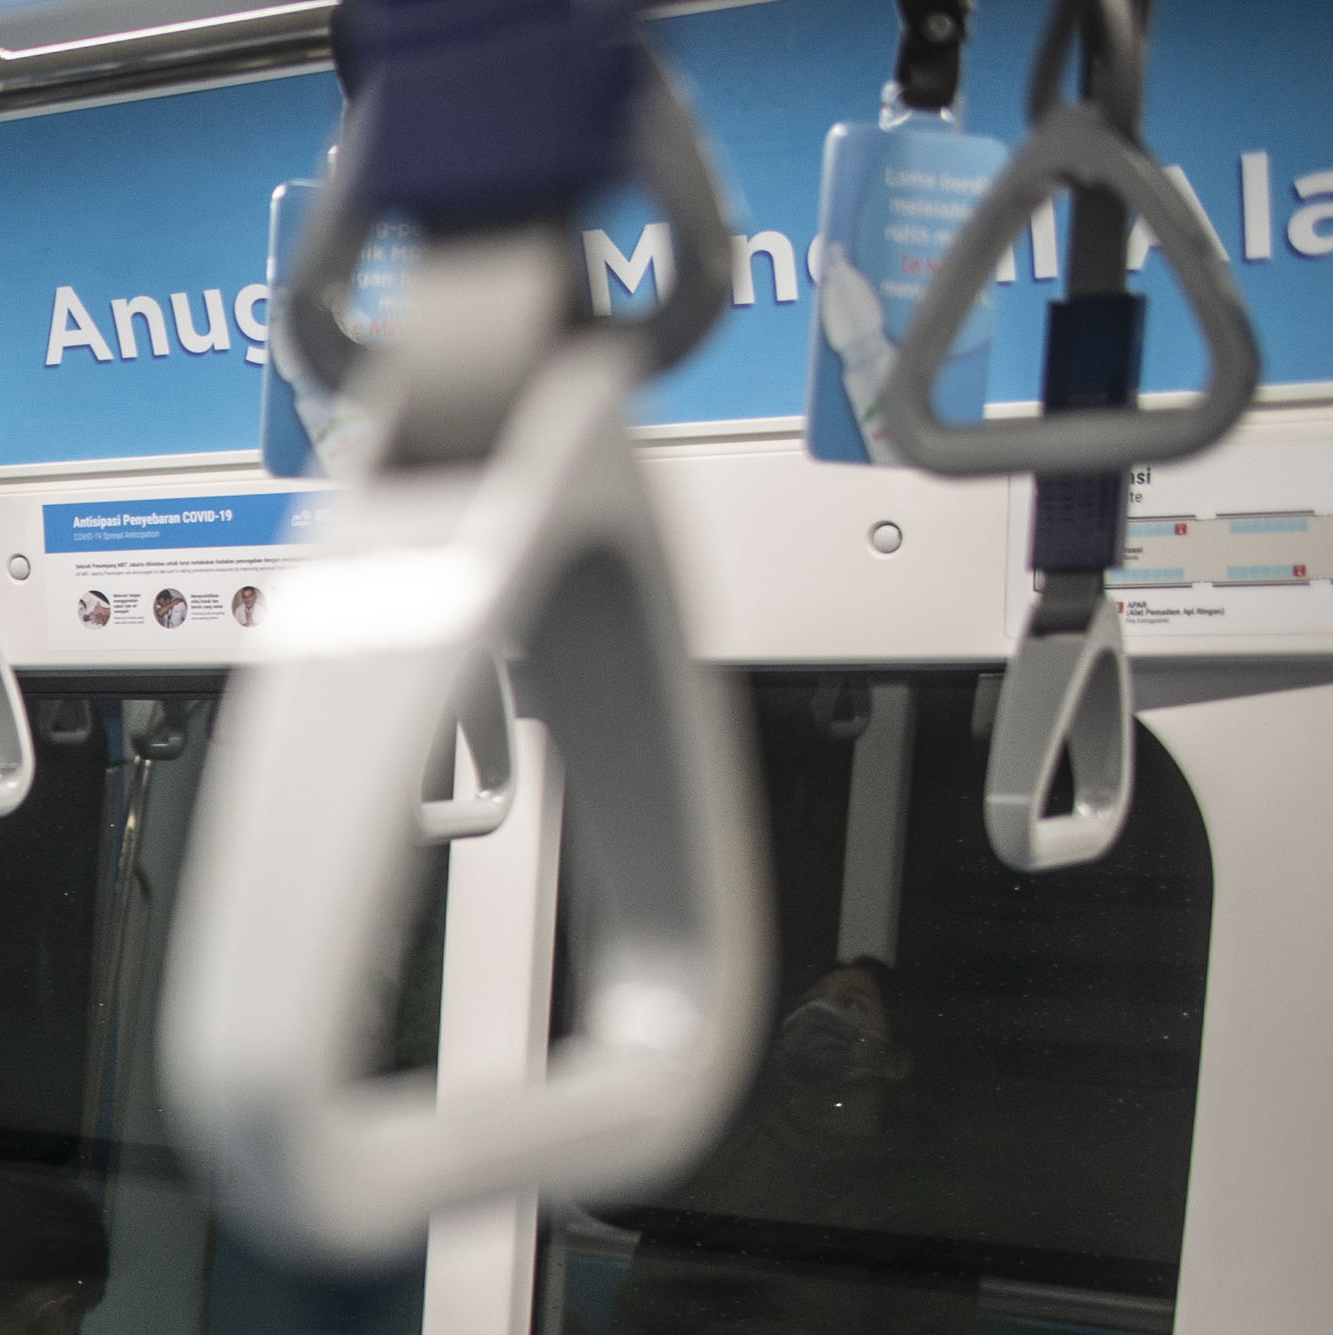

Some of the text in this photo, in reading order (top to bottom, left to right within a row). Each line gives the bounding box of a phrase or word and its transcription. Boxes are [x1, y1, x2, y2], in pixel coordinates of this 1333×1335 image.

[44, 283, 269, 366] Anug
[73, 509, 233, 530] Antisipasi Penyebaran COVID-19
[73, 531, 102, 541] COVID-19
